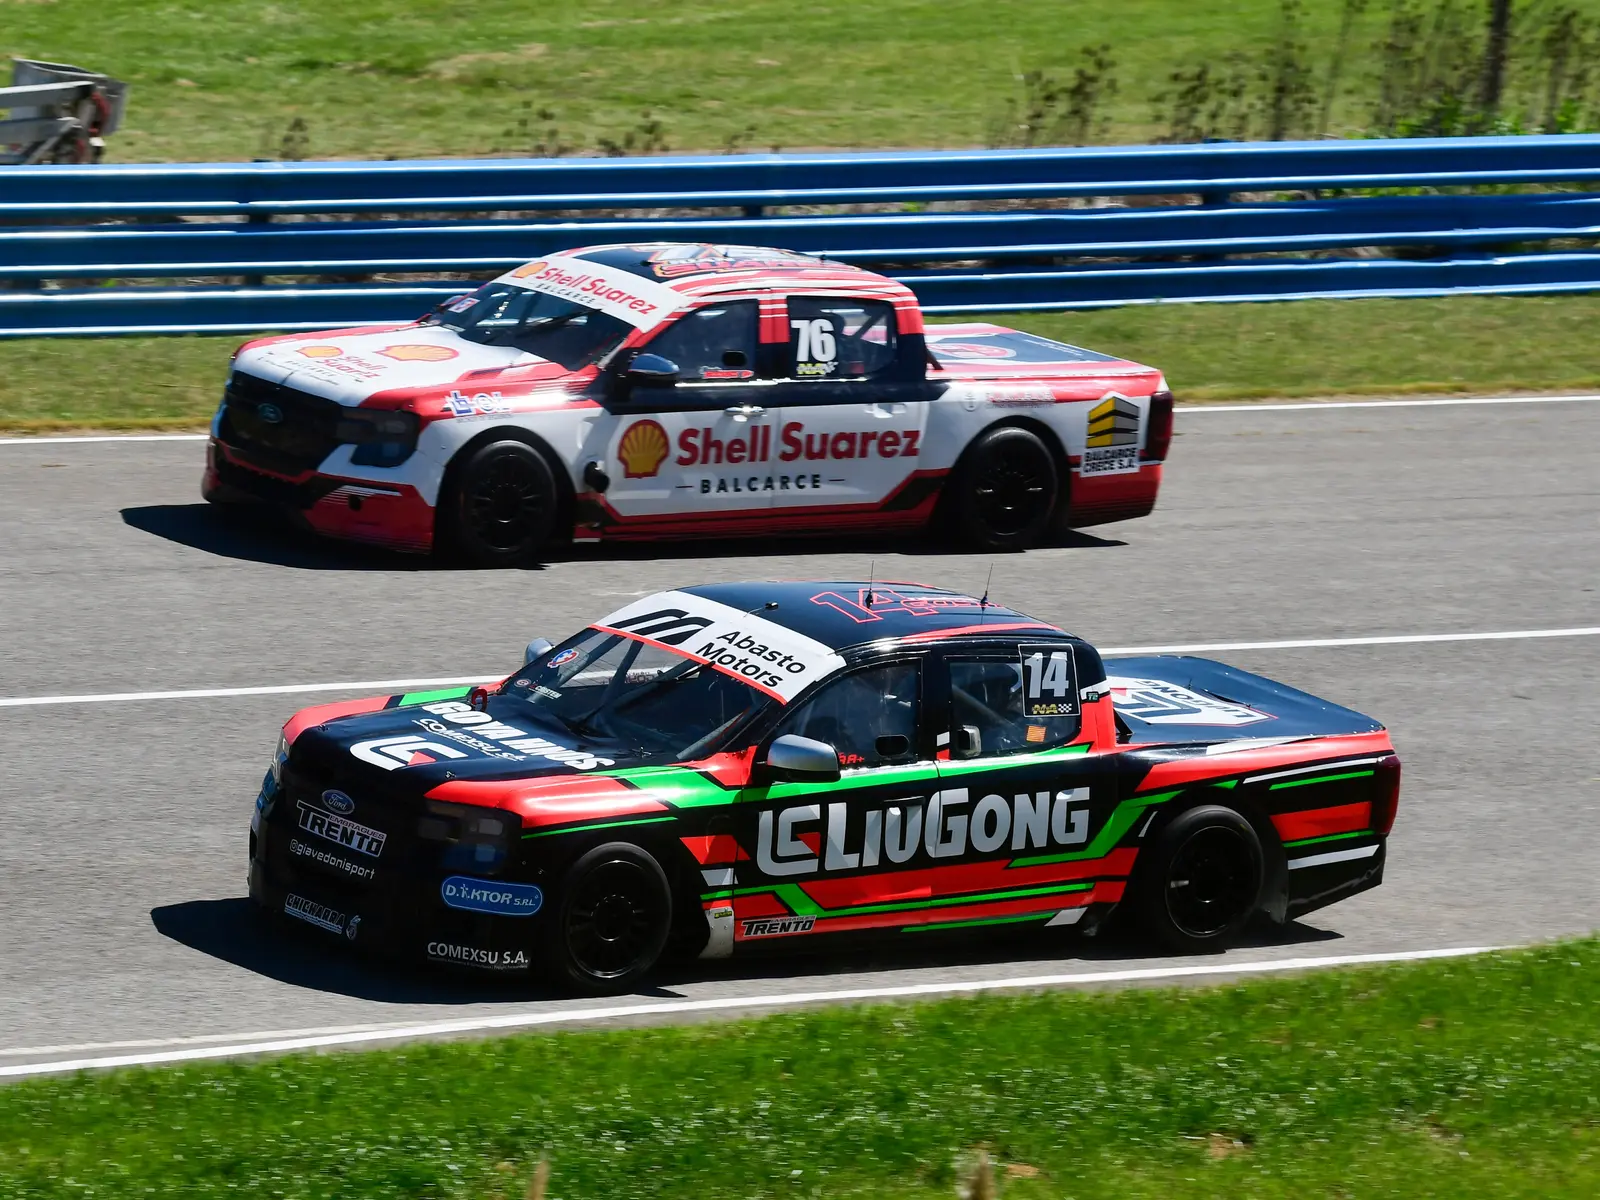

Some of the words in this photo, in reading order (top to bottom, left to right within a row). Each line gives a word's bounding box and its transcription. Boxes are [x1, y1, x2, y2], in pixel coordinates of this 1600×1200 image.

[536, 267, 590, 288] Shell
[581, 278, 658, 315] Suarez
[791, 318, 836, 362] 76
[675, 424, 770, 466] Shell
[779, 421, 920, 462] Suarez
[701, 474, 821, 494] BALCARCE
[694, 642, 784, 688] Motors
[716, 630, 806, 674] Abasto
[1024, 651, 1069, 698] 14
[422, 701, 528, 740] GOYA
[499, 738, 615, 770] HNOS
[297, 800, 386, 857] TRENTO
[329, 814, 385, 840] EMBRAGUES
[824, 787, 1090, 871] LIUGONG
[290, 838, 375, 879] @giavedonisport
[742, 919, 815, 936] TRENTO
[427, 942, 498, 964] COMEXSU
[502, 950, 529, 964] S.A.
